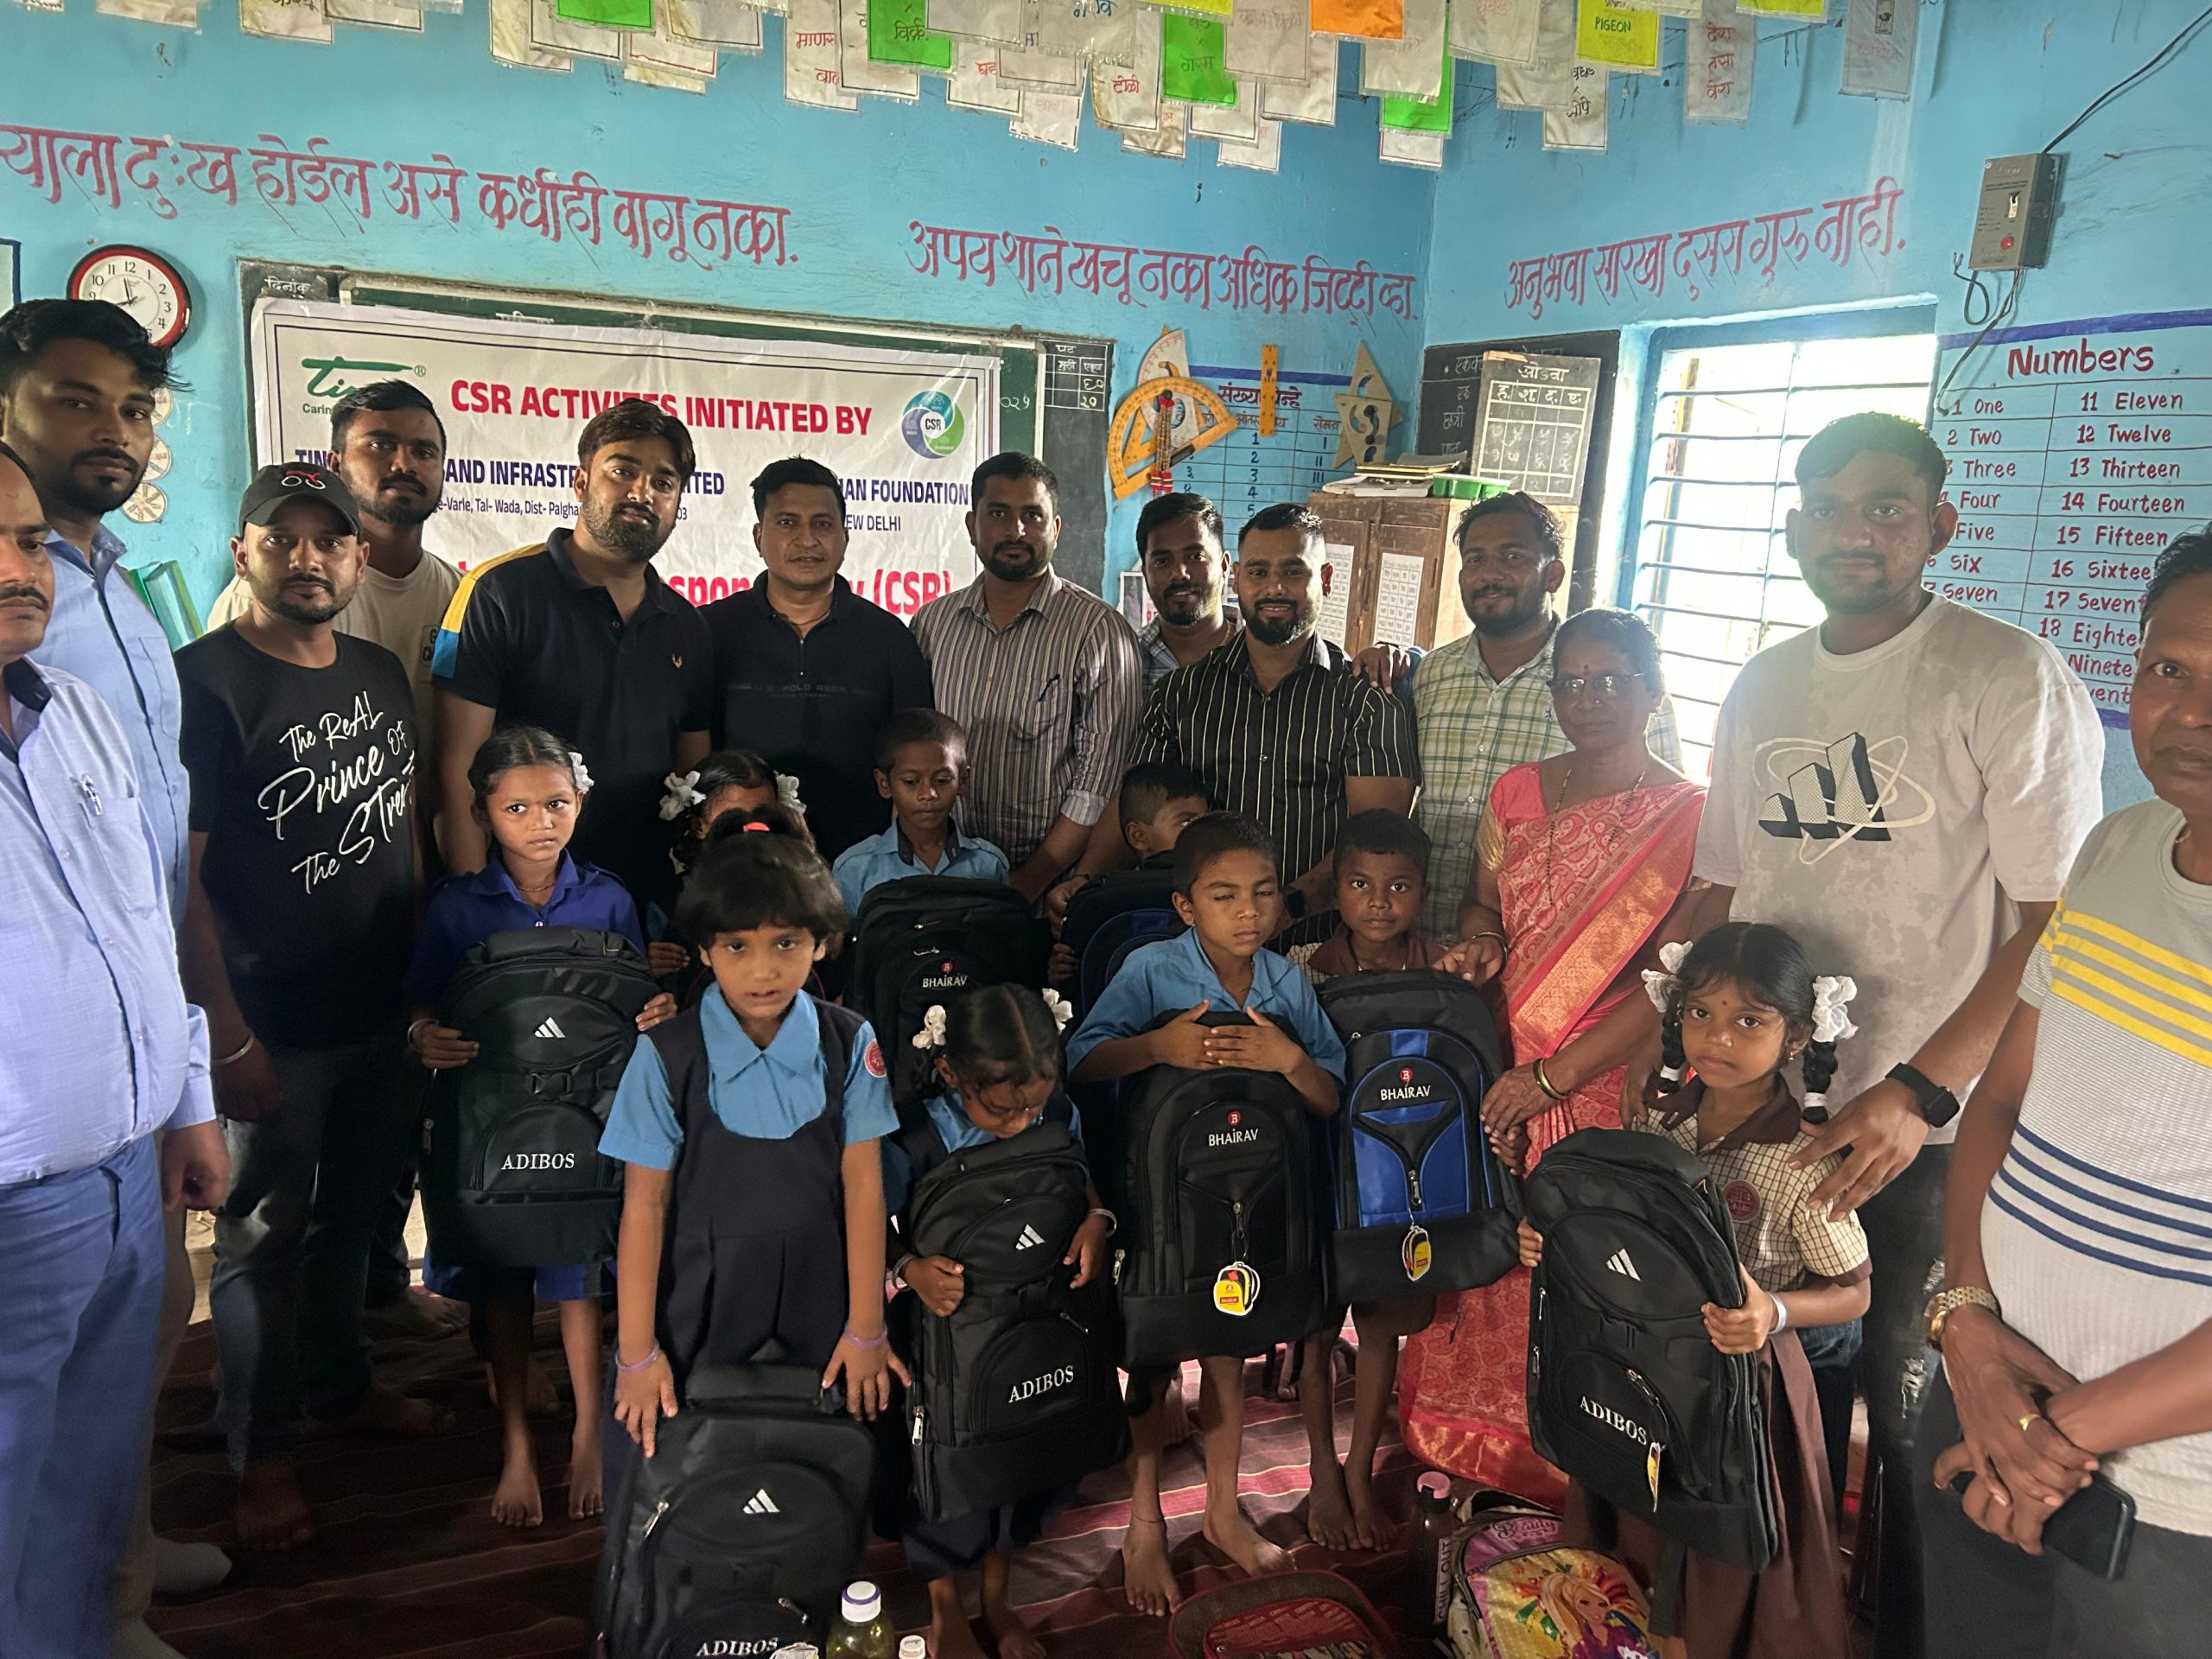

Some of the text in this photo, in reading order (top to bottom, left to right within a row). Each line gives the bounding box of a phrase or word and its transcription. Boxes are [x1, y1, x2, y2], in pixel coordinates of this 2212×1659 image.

[1595, 16, 1631, 33] PIGEON
[382, 154, 468, 230] असे
[107, 264, 115, 275] 11
[124, 261, 137, 274] 12
[92, 274, 105, 286] 10
[158, 283, 167, 296] 2
[1215, 245, 1298, 315] अधिक
[163, 302, 172, 313] 3
[157, 317, 166, 329] 4
[2007, 338, 2155, 379] Numbers
[302, 403, 332, 415] Carin
[451, 378, 512, 415] CSR
[685, 396, 829, 434] INITIATED
[836, 405, 873, 436] BY
[1951, 398, 2004, 416] 1 One
[2081, 391, 2183, 411] 11 Eleven
[925, 418, 942, 430] CSR
[2076, 423, 2171, 443] 12 Twelve
[1252, 432, 1260, 445] 1
[1947, 428, 2002, 445] 2 Two
[295, 449, 327, 469] TIN
[445, 459, 486, 484] AND
[1250, 451, 1260, 464] 2
[1250, 468, 1258, 482] 3
[1963, 459, 2017, 478] Three
[2069, 457, 2181, 479] 13 Thirteen
[871, 479, 969, 505] FOUNDATION
[1247, 486, 1258, 499] 4
[1960, 491, 2001, 508] Four
[494, 499, 523, 516] Wada,
[524, 499, 547, 515] Dist-
[549, 501, 580, 519] Palgha
[1247, 504, 1255, 518] 5
[2061, 492, 2185, 513] 14 Fourteen
[845, 514, 901, 531] EW DELHI
[1955, 522, 1994, 541] Five
[2056, 524, 2168, 547] 15 Fifteen
[1949, 554, 1982, 574] Six
[2051, 559, 2152, 581] 16 Sixtee
[1942, 582, 1998, 603] Seven
[2044, 591, 2148, 614] 17 Sevent
[2038, 617, 2141, 649] 18 Eighte
[2068, 653, 2133, 677] Ninete
[279, 724, 316, 762] The
[257, 746, 385, 841] Prince
[291, 852, 340, 894] The
[501, 1154, 575, 1170] ADIBOS
[1008, 1364, 1074, 1404] ADIBOS
[1580, 1395, 1648, 1446] ADIBOS
[696, 1637, 779, 1657] ADIBOS
